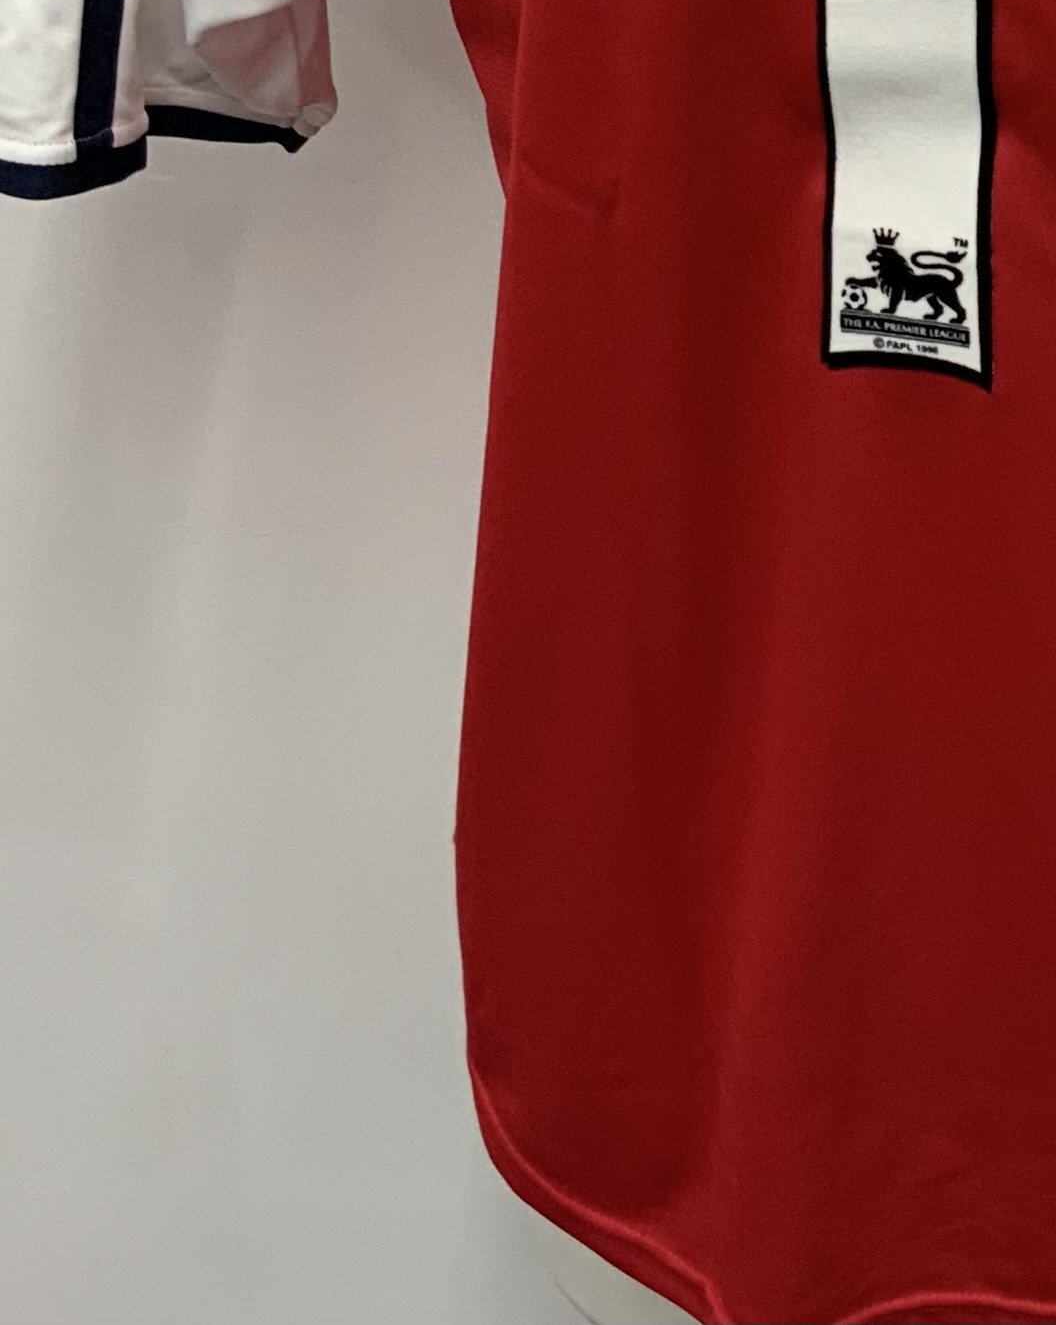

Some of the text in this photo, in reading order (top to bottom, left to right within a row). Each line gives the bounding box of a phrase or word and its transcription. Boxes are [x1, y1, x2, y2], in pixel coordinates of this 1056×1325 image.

[954, 237, 969, 248] TM
[843, 317, 862, 328] THE
[884, 322, 926, 336] PREMIER
[929, 328, 966, 342] LEAGUE
